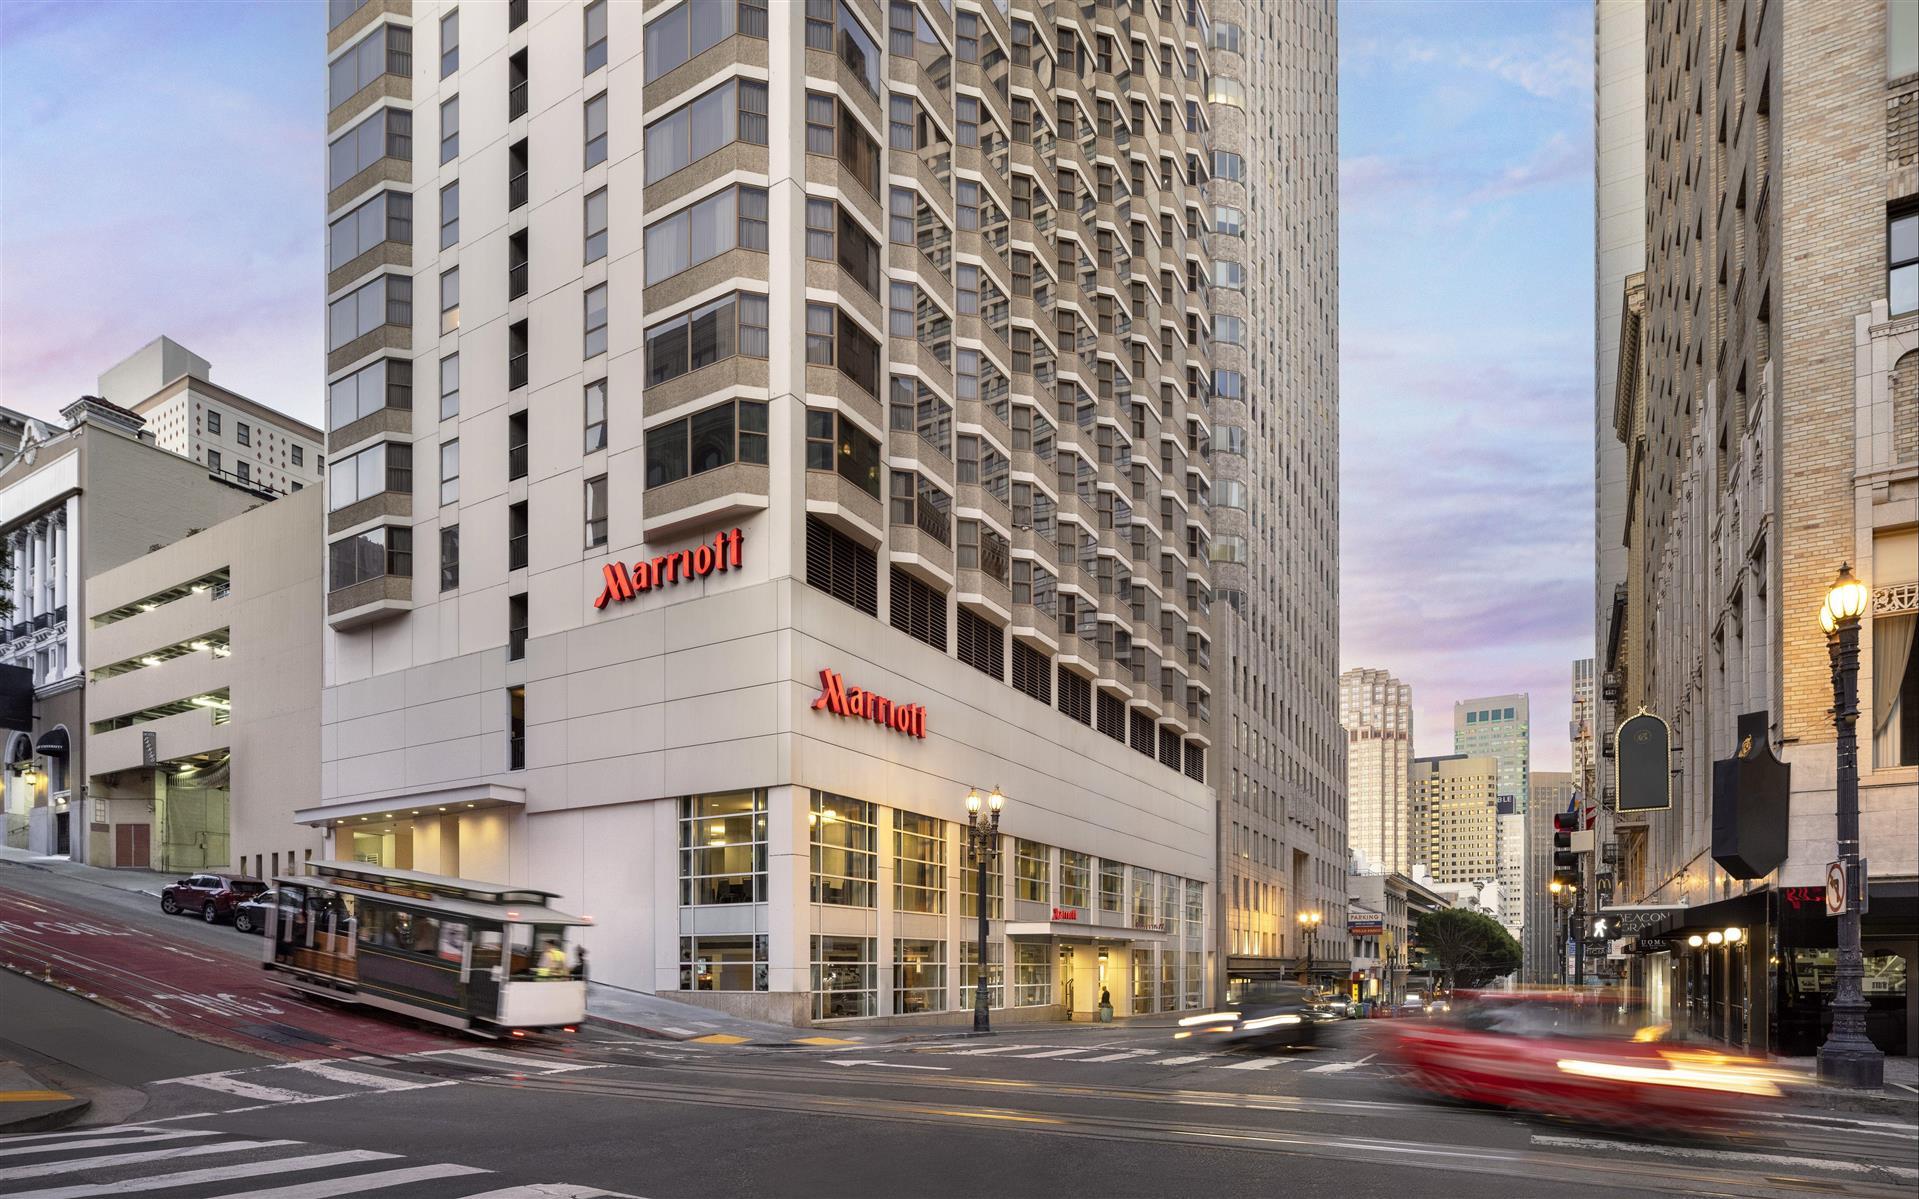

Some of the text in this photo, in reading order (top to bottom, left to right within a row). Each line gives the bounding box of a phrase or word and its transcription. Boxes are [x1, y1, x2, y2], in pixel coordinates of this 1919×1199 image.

[594, 527, 744, 609] Marriott
[810, 667, 927, 739] Marriott
[1616, 912, 1671, 922] EACON
